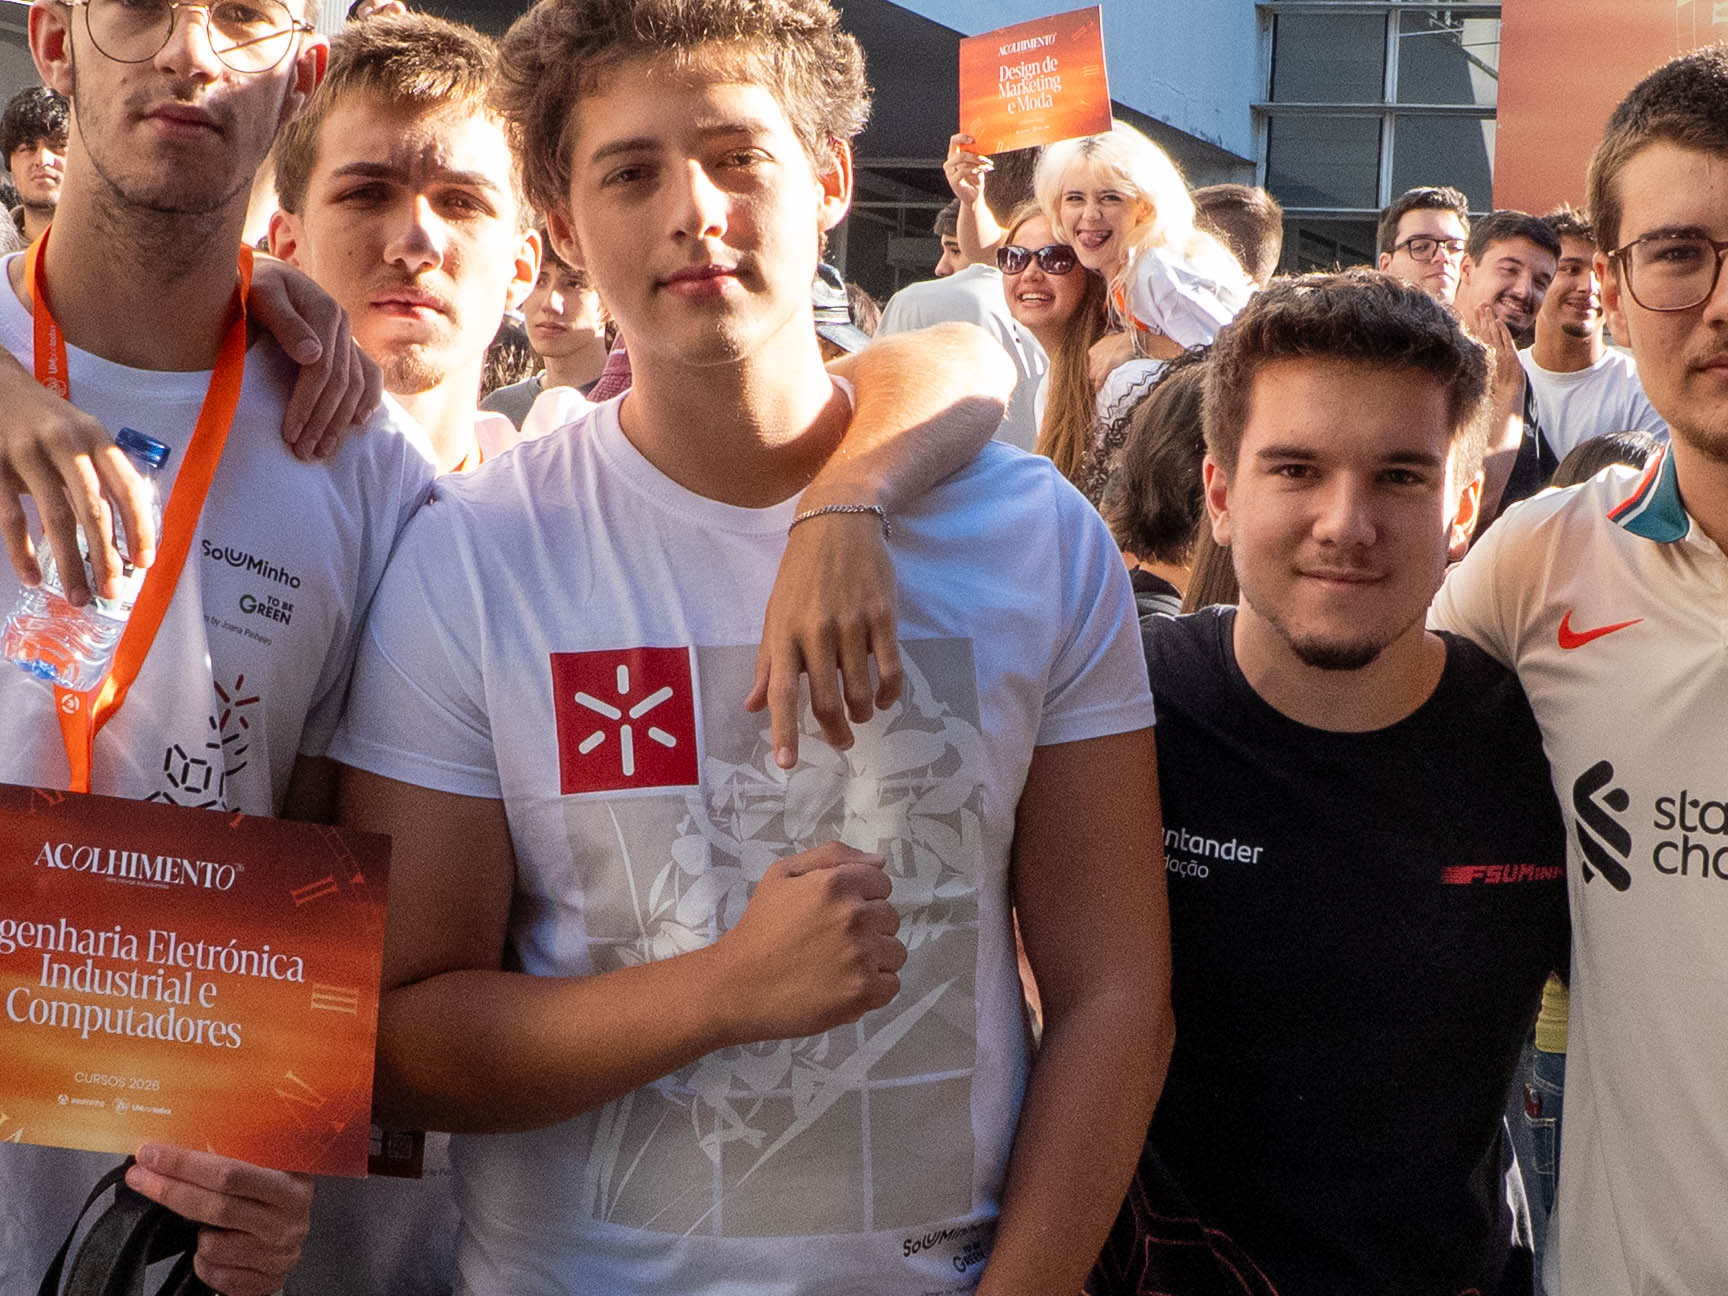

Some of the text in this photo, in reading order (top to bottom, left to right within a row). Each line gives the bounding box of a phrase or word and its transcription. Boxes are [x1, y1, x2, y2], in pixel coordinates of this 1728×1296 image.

[998, 55, 1059, 82] Design de
[998, 74, 1062, 99] Marketing
[1017, 94, 1054, 112] Moda
[239, 594, 292, 626] GREEN
[267, 595, 295, 613] TO BE
[1162, 827, 1264, 864] ntander
[33, 841, 236, 892] ACOLHIMENTO
[145, 928, 306, 984] Eletrónica
[38, 953, 218, 1010] Industrial e
[5, 986, 243, 1050] Computadores
[74, 1071, 126, 1089] CURSOS
